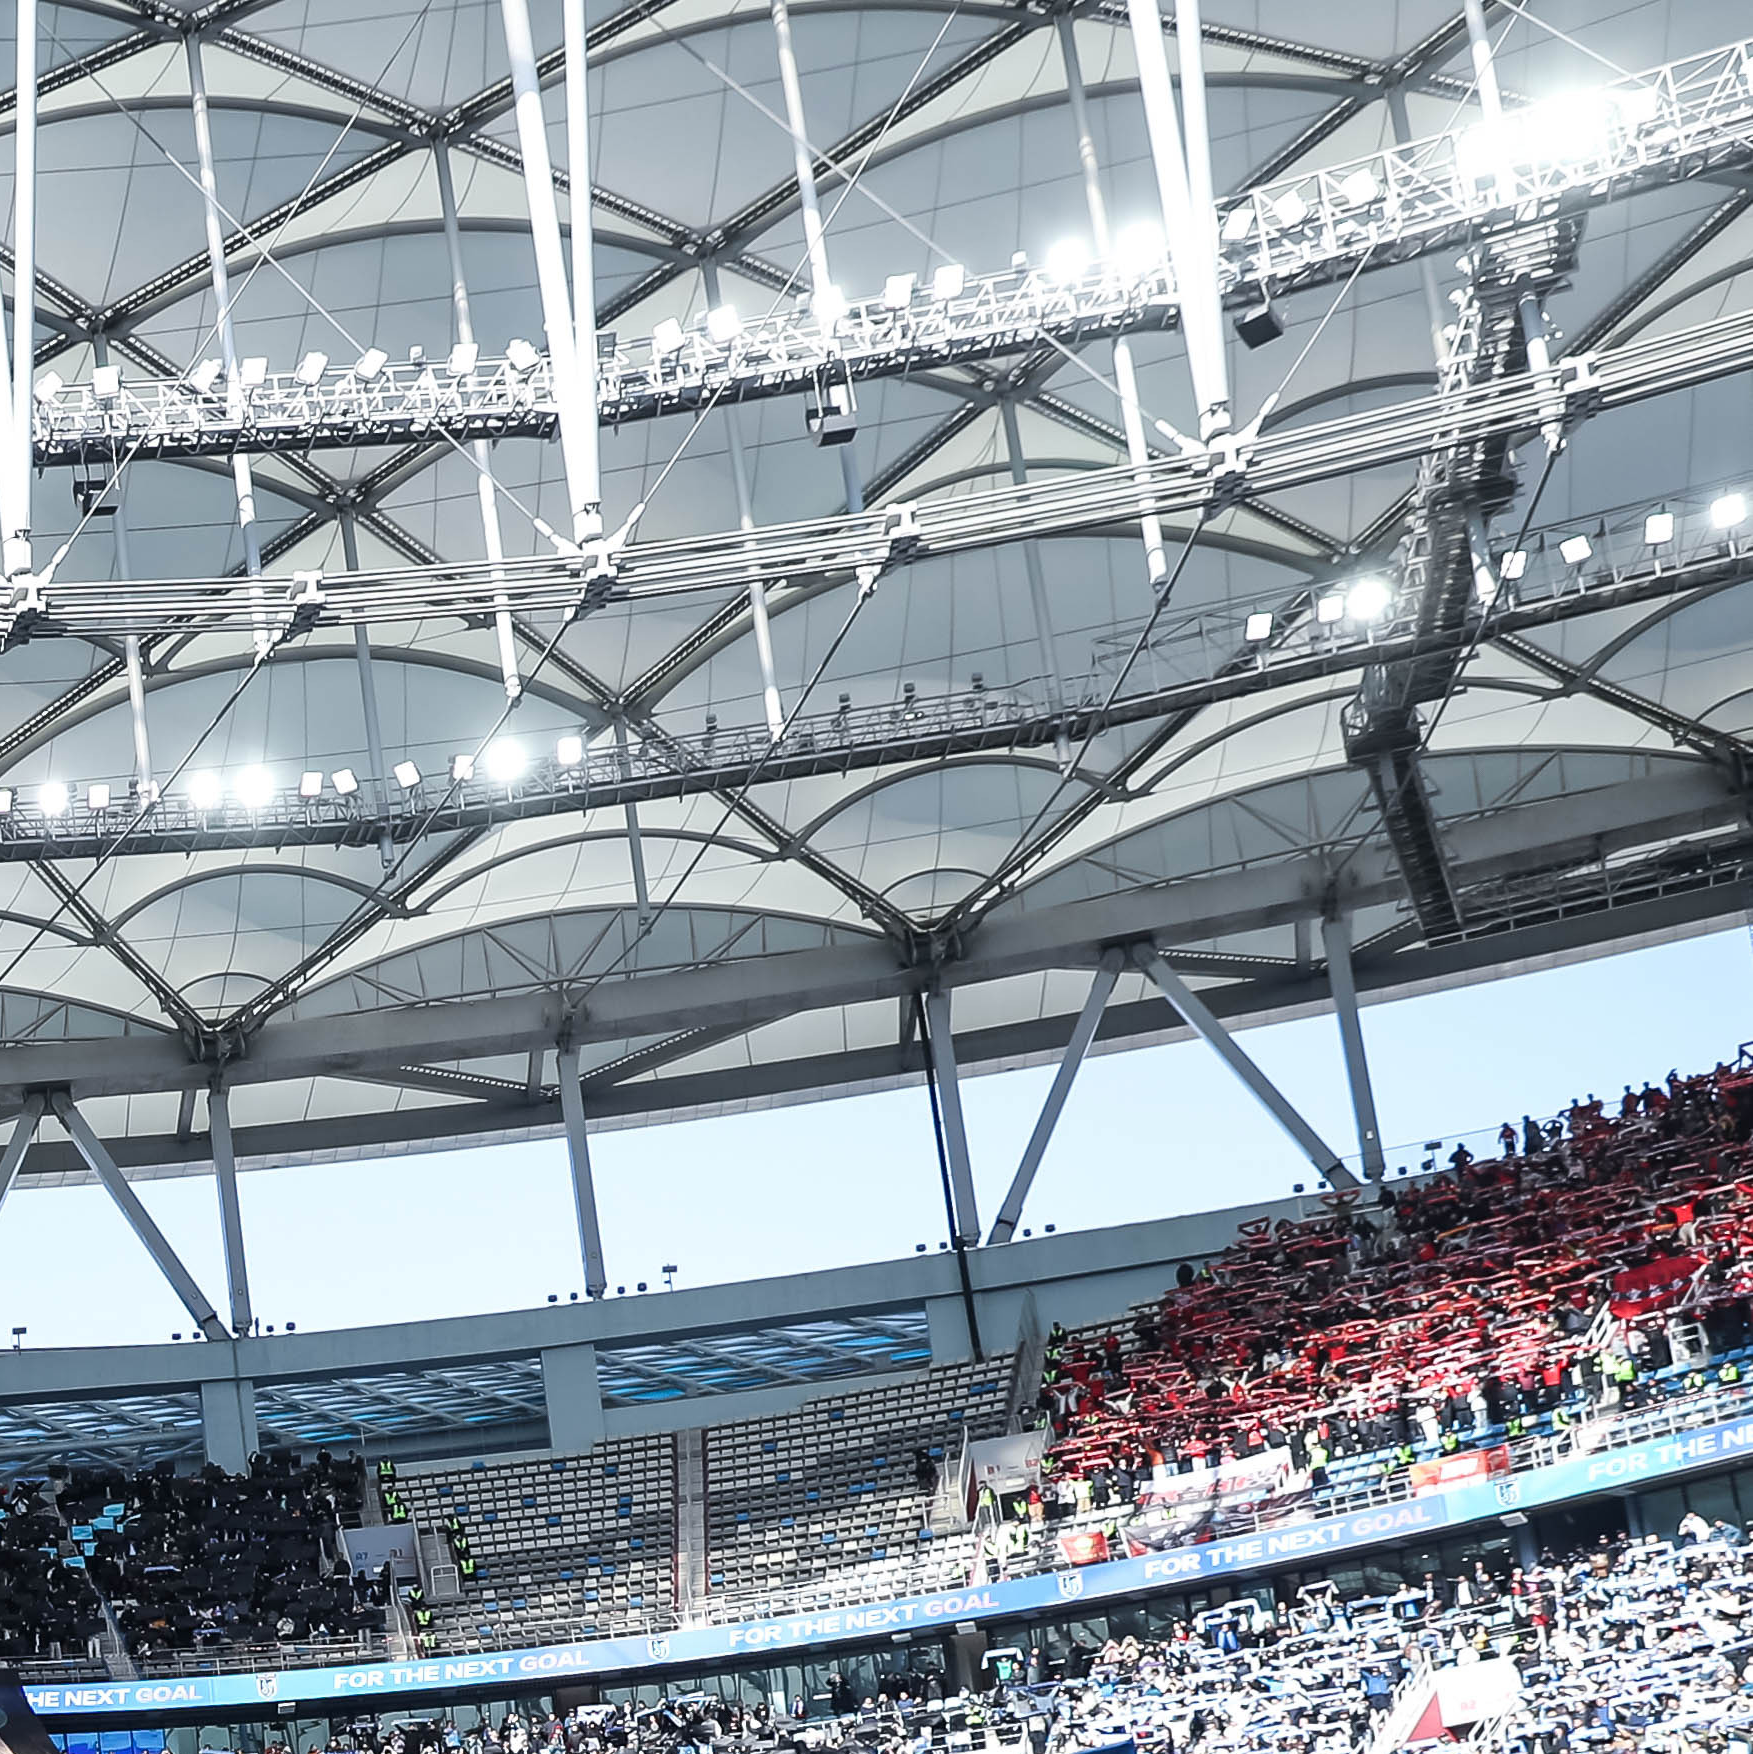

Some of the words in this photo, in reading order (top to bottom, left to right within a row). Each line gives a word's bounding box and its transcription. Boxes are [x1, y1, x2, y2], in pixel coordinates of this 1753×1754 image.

[1588, 1452, 1649, 1481] FOR
[1654, 1434, 1717, 1464] THE
[1144, 1552, 1201, 1579] FOR
[1206, 1540, 1263, 1566] THE
[1267, 1523, 1348, 1555] NEXT
[1351, 1506, 1431, 1535] GOAL
[729, 1625, 782, 1647] FOR
[787, 1615, 841, 1638] THE
[845, 1604, 918, 1630] NEXT
[923, 1592, 1000, 1616] GOAL
[334, 1670, 384, 1690] FOR
[389, 1666, 439, 1686] THE
[444, 1657, 516, 1680] NEXT
[520, 1651, 589, 1673] GOAL
[25, 1690, 60, 1708] HE
[65, 1687, 127, 1706] NEXT
[135, 1684, 202, 1704] GOAL
